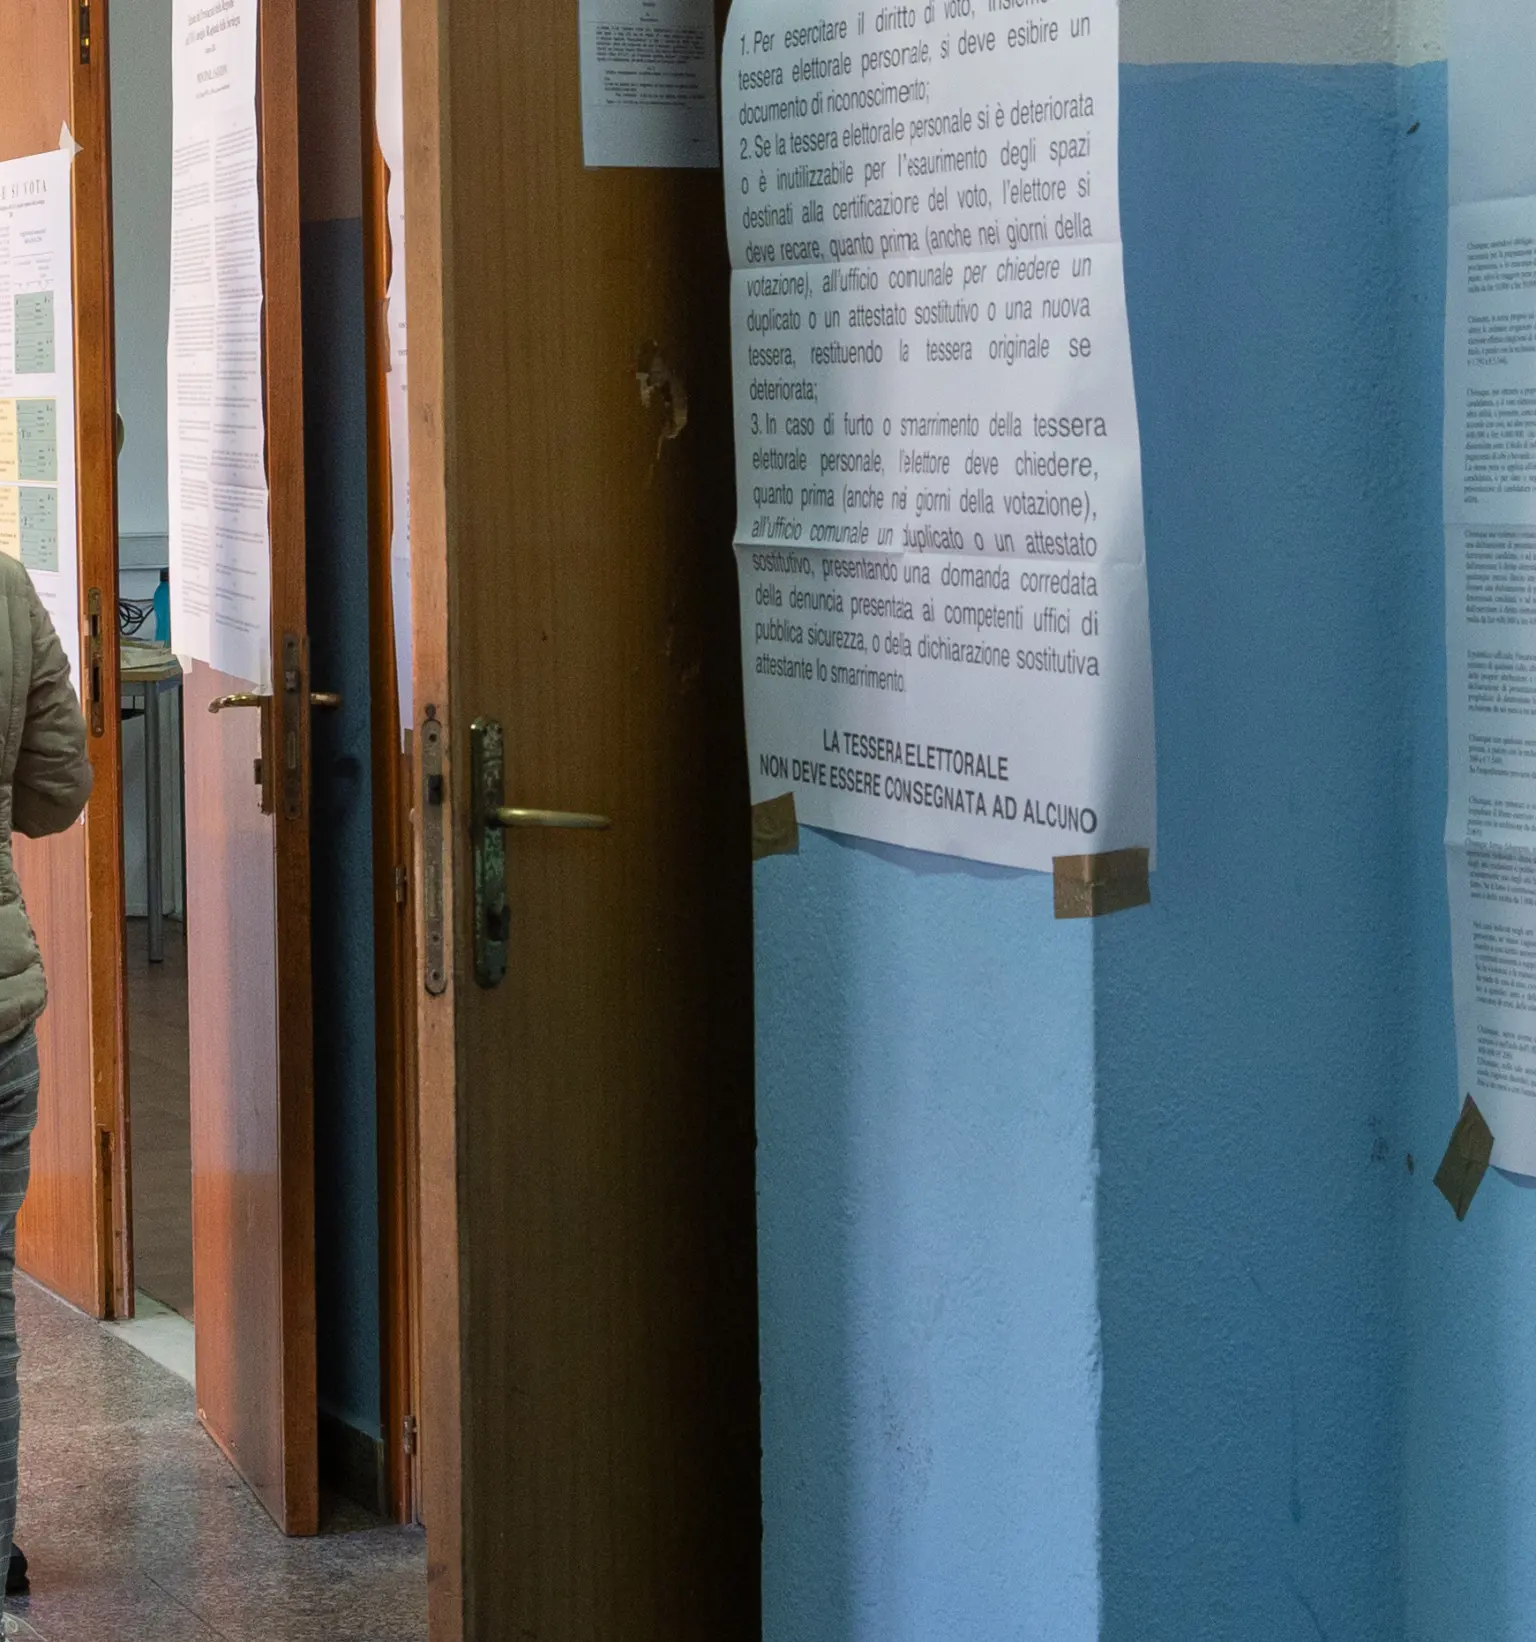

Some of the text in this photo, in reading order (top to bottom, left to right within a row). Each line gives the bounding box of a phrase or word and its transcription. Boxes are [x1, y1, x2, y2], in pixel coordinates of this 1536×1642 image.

[741, 35, 749, 55] 1.
[753, 30, 775, 53] Per
[784, 20, 847, 49] esercitare
[858, 11, 864, 35] il
[875, 6, 916, 32] diritto
[924, 0, 935, 25] di
[944, 0, 975, 19] voto,
[738, 16, 1090, 90] tessera elettorale personale, si deve esibire un
[739, 79, 929, 126] documento di riconoscimento;
[740, 93, 1094, 160] 2. Se la tessera elettorale personale si è deteriorata
[741, 137, 1090, 194] o è inutilizzabile per l'esaurimento degli spazi
[11, 182, 19, 199] SI
[23, 178, 47, 196] VOTA
[743, 178, 1090, 229] destinati alla certificazione del voto, l'elettore si
[746, 212, 1093, 264] deve recare, quanto prima (anche nei giorni della
[748, 256, 1091, 299] votazione), all'ufficio comunale per chiedere un
[747, 297, 1090, 336] duplicato o un attestato sostitutivo o una nuova
[748, 333, 1091, 368] tessera, restituendo la tessera originale se
[750, 377, 817, 403] deteriorata;
[751, 412, 1107, 438] 3. In caso di furto o smarrimento della tessera
[753, 448, 1098, 480] elettorale personale, l'elettore deve chiedere,
[754, 484, 1096, 523] quanto prima (anche nei giorni della votazione),
[752, 516, 1097, 557] all'ufficio comunale un duplicato o un attestato
[752, 552, 1098, 596] sostitutivo, presentando una domanda corredata
[756, 584, 1098, 636] della denuncia presentata ai competenti uffici di
[756, 618, 1099, 676] pubblica sicurezza, o della dichiarazione sostitutiva
[756, 653, 906, 692] attestante lo smarrimento.
[823, 729, 1009, 781] LA TESSERA ELETTORALE
[760, 754, 1097, 834] NON DEVE ESSERE CONSEGNATA AD ALCUNO
